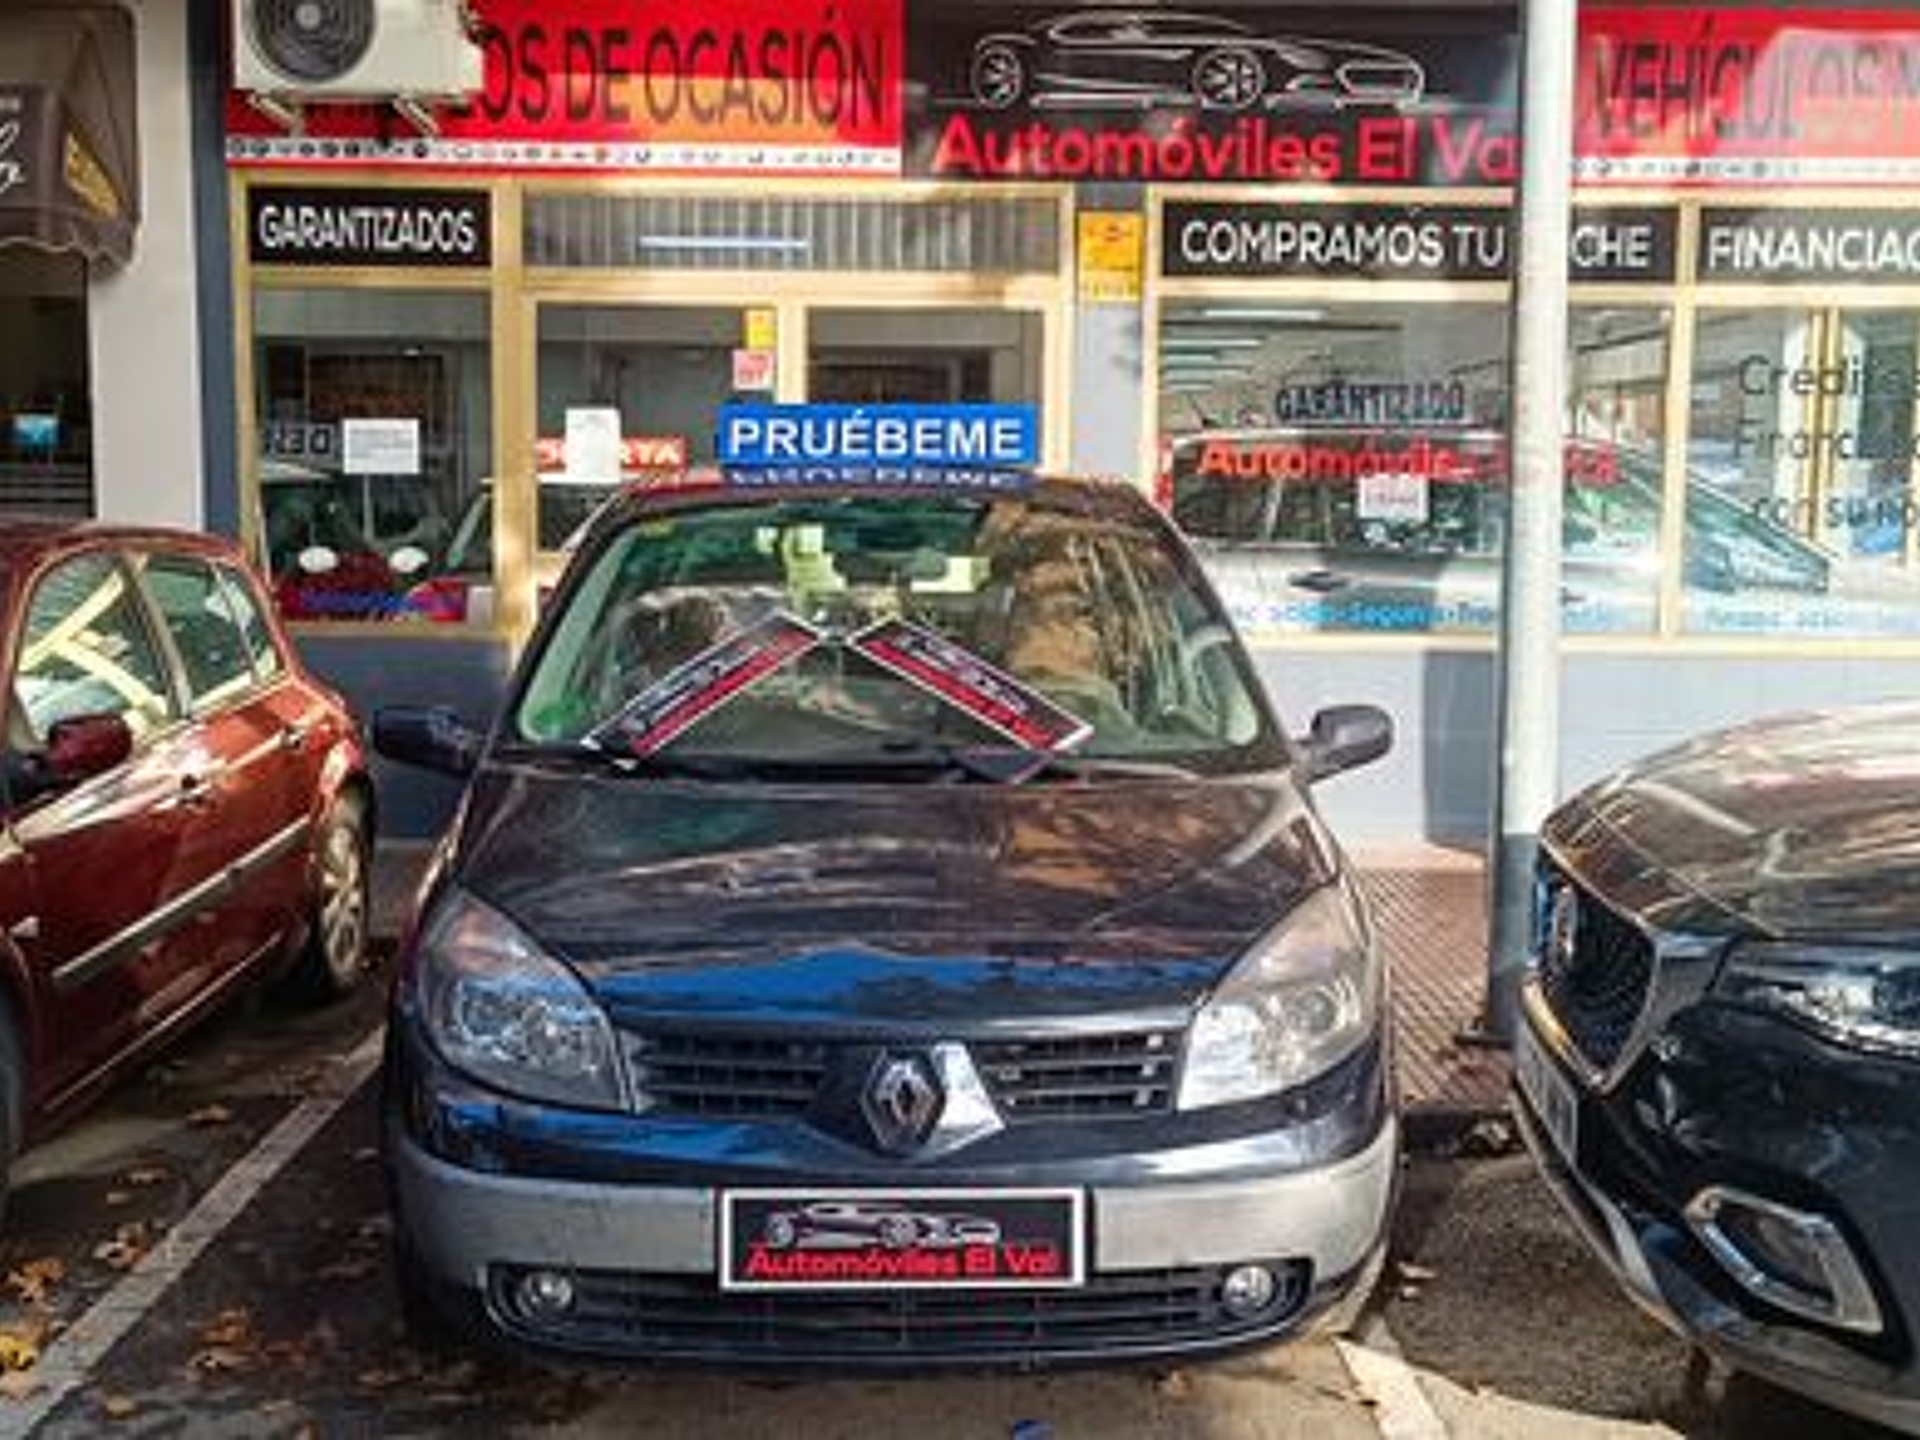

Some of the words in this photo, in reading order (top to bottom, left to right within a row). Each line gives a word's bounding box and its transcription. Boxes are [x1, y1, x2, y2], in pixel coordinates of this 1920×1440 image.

[564, 28, 629, 122] DE
[643, 5, 883, 128] OCASIÓN
[1590, 14, 1882, 139] VEHÍCULOS
[932, 111, 1340, 180] Automóviles
[1357, 118, 1415, 179] El
[1430, 116, 1522, 180] Va
[257, 205, 477, 254] GARANTIZADOS
[1180, 221, 1444, 267] COMPRAMOS
[1452, 224, 1505, 268] TU
[1570, 225, 1653, 269] CHE
[729, 408, 1023, 458] PRUÉBEME
[746, 1242, 958, 1276] Automóviles
[964, 1242, 995, 1275] El
